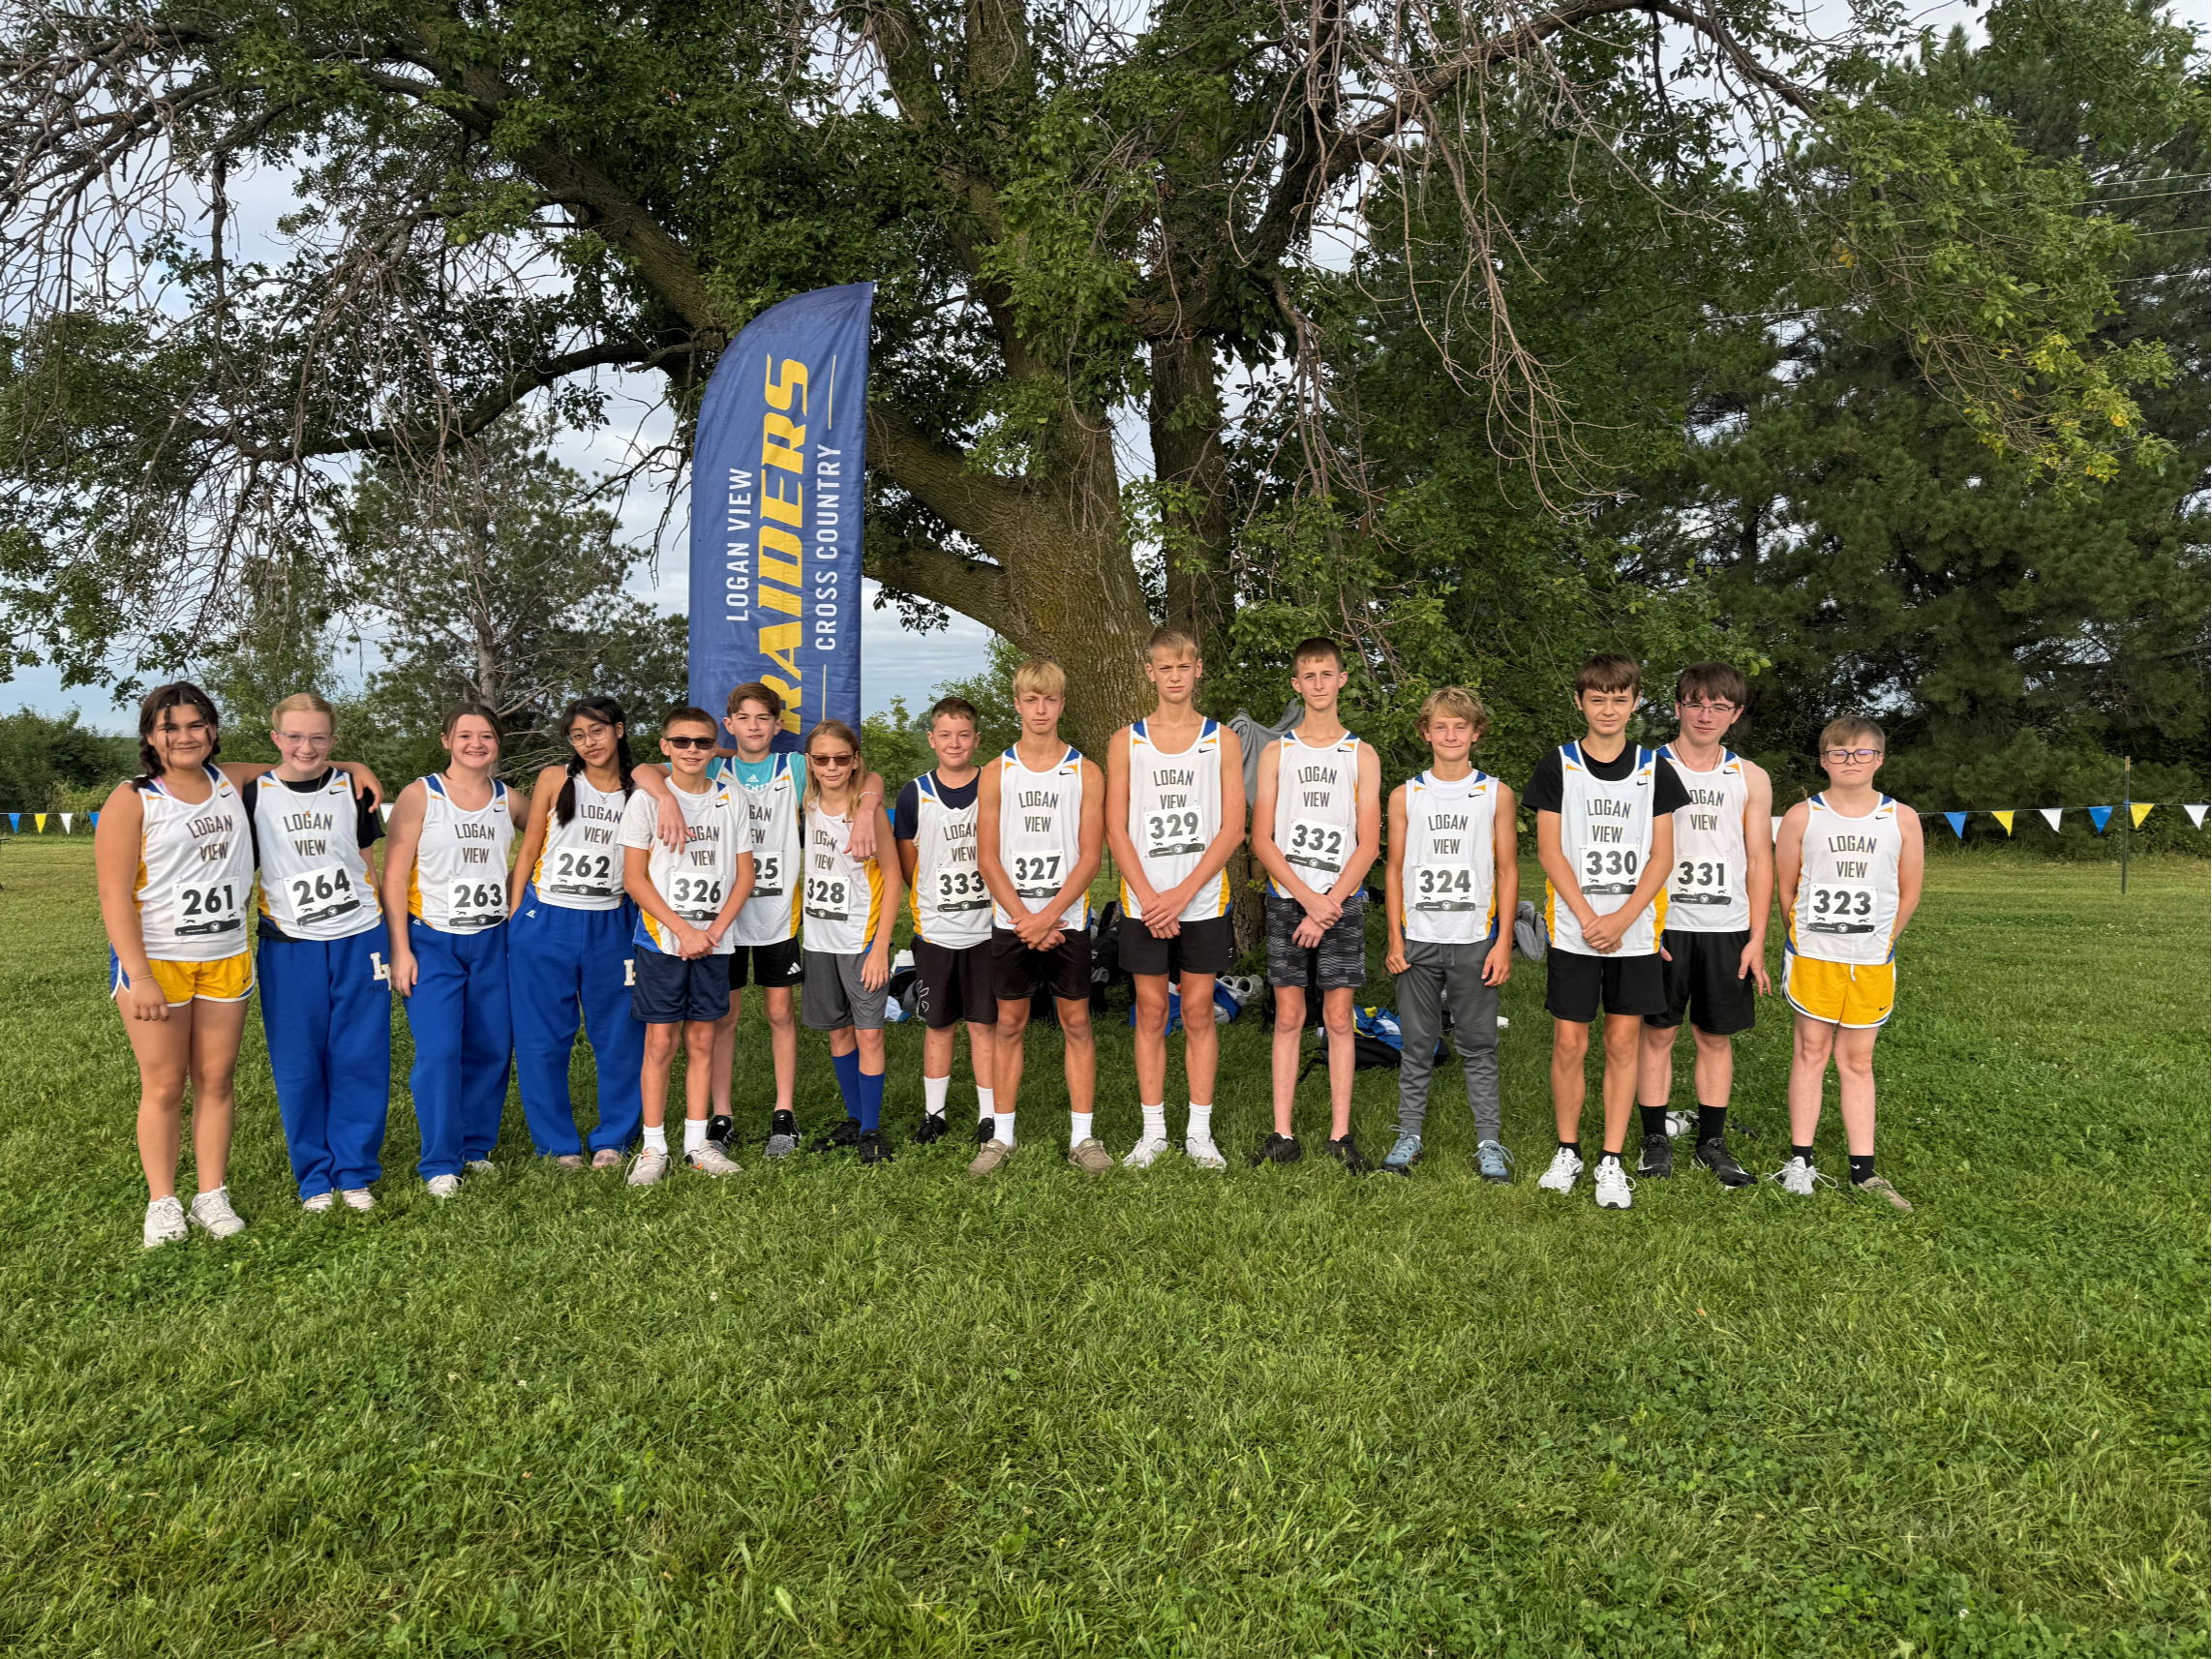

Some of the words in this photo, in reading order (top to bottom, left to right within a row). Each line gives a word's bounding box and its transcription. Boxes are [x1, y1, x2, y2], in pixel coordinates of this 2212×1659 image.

[728, 468, 752, 531] VIEW
[815, 443, 841, 560] COUNTRY
[725, 541, 749, 622] LOGAN
[814, 570, 837, 650] CROSS
[1153, 769, 1195, 787] LOGAN
[1297, 766, 1338, 785] LOGAN
[1018, 790, 1059, 810] LOGAN
[1159, 794, 1187, 809] VIEW
[1303, 791, 1330, 807] VIEW
[1689, 789, 1724, 807] OGAN
[581, 804, 622, 824] LOGAN
[1587, 799, 1631, 819] LOGAN
[186, 815, 232, 838] LOGAN
[283, 813, 333, 832] LOGAN
[454, 823, 495, 841] LOGAN
[1024, 816, 1051, 832] VIEW
[1148, 811, 1198, 840] 329
[1428, 814, 1469, 831] LOGAN
[1690, 814, 1717, 830] VIEW
[585, 826, 613, 845] VIEW
[685, 826, 720, 843] OGAN
[1291, 824, 1343, 855] 332
[1591, 825, 1623, 844] VIEW
[1828, 835, 1877, 854] LOGAN
[199, 842, 228, 861] VIEW
[294, 839, 326, 857] VIEW
[462, 847, 490, 863] VIEW
[952, 846, 977, 861] VIEW
[1433, 838, 1461, 855] VIEW
[557, 853, 610, 879] 262
[690, 851, 715, 866] VIEW
[1015, 856, 1061, 880] 327
[1586, 850, 1637, 876] 330
[753, 858, 778, 880] 25
[1678, 861, 1725, 886] 331
[1836, 860, 1867, 879] VIEW
[292, 868, 350, 907] 264
[674, 878, 721, 904] 326
[807, 878, 845, 904] 328
[939, 871, 985, 895] 333
[1419, 869, 1471, 893] 324
[182, 885, 233, 916] 261
[453, 883, 502, 908] 263
[1812, 890, 1871, 916] 323
